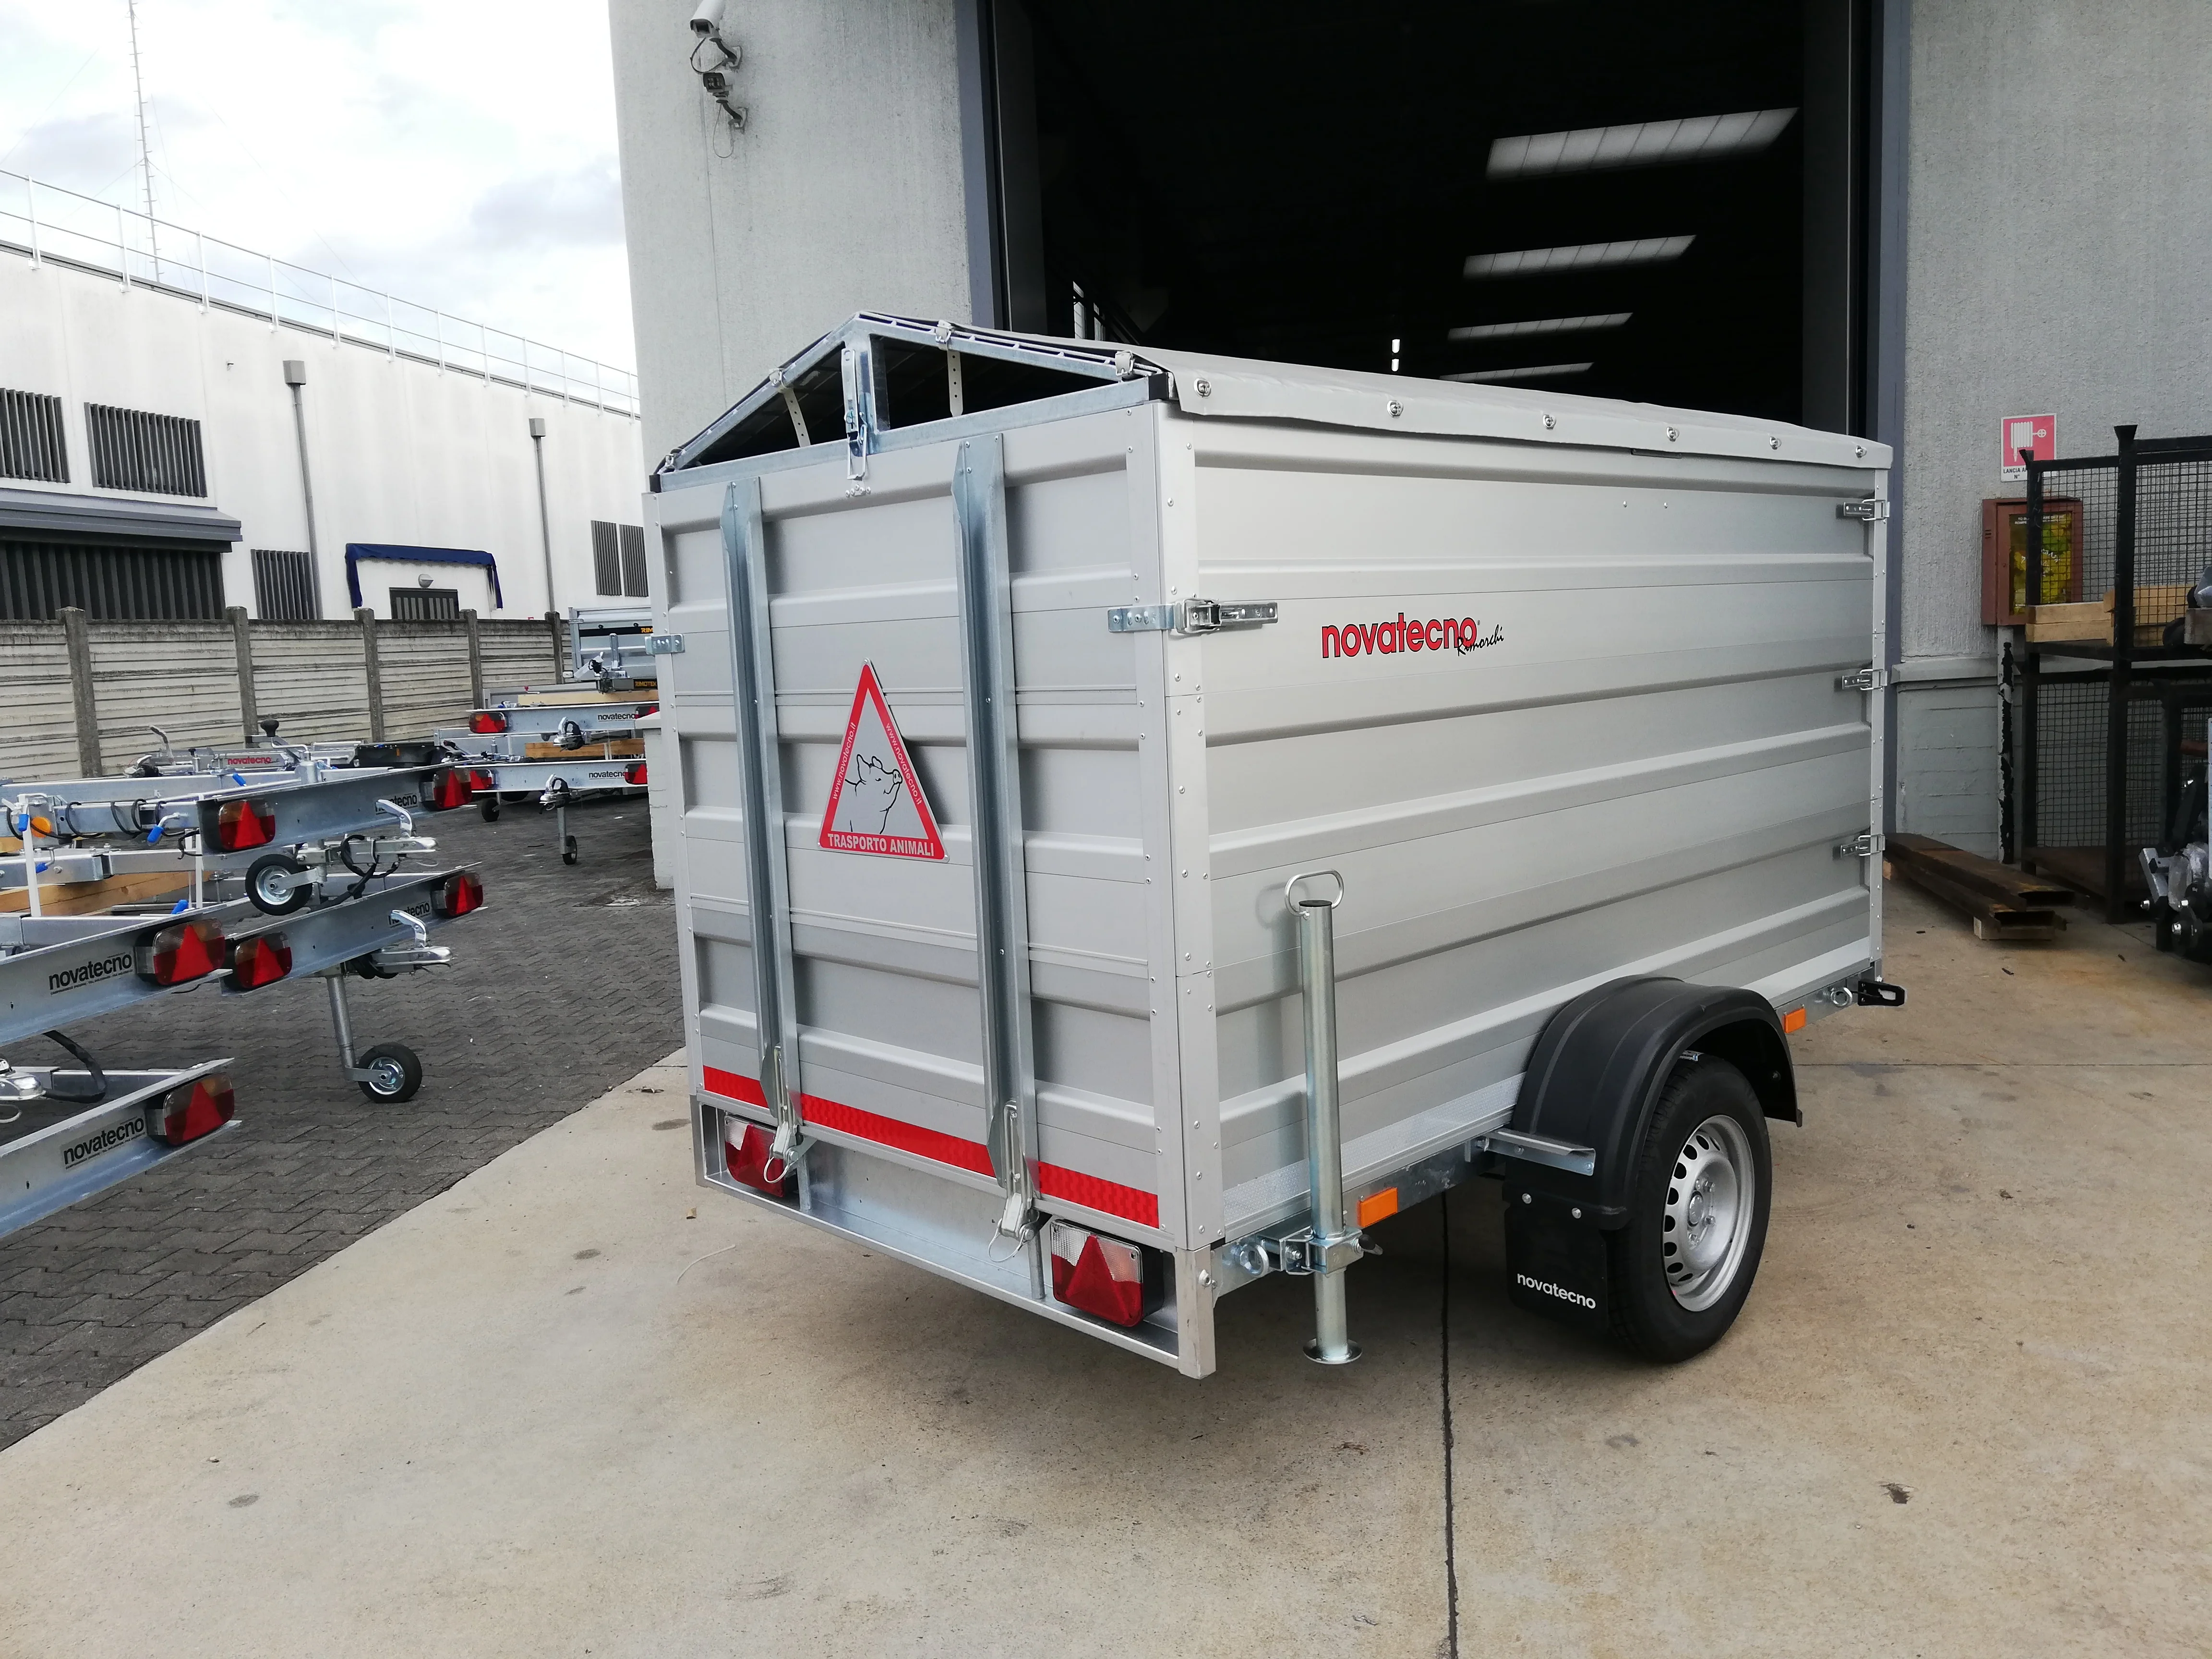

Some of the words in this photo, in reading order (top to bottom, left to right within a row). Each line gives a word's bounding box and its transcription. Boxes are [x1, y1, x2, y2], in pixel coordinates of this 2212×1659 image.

[1322, 613, 1477, 658] novatecno
[228, 756, 272, 765] novatecno
[833, 722, 856, 800] www.novatecno.it
[886, 723, 923, 805] www.novatecno.it
[828, 833, 887, 852] TRASPORTO
[890, 839, 934, 856] ANIMALI
[48, 954, 132, 990] novatecno
[63, 1118, 144, 1165] novatecno
[1517, 1273, 1596, 1309] novatecno
